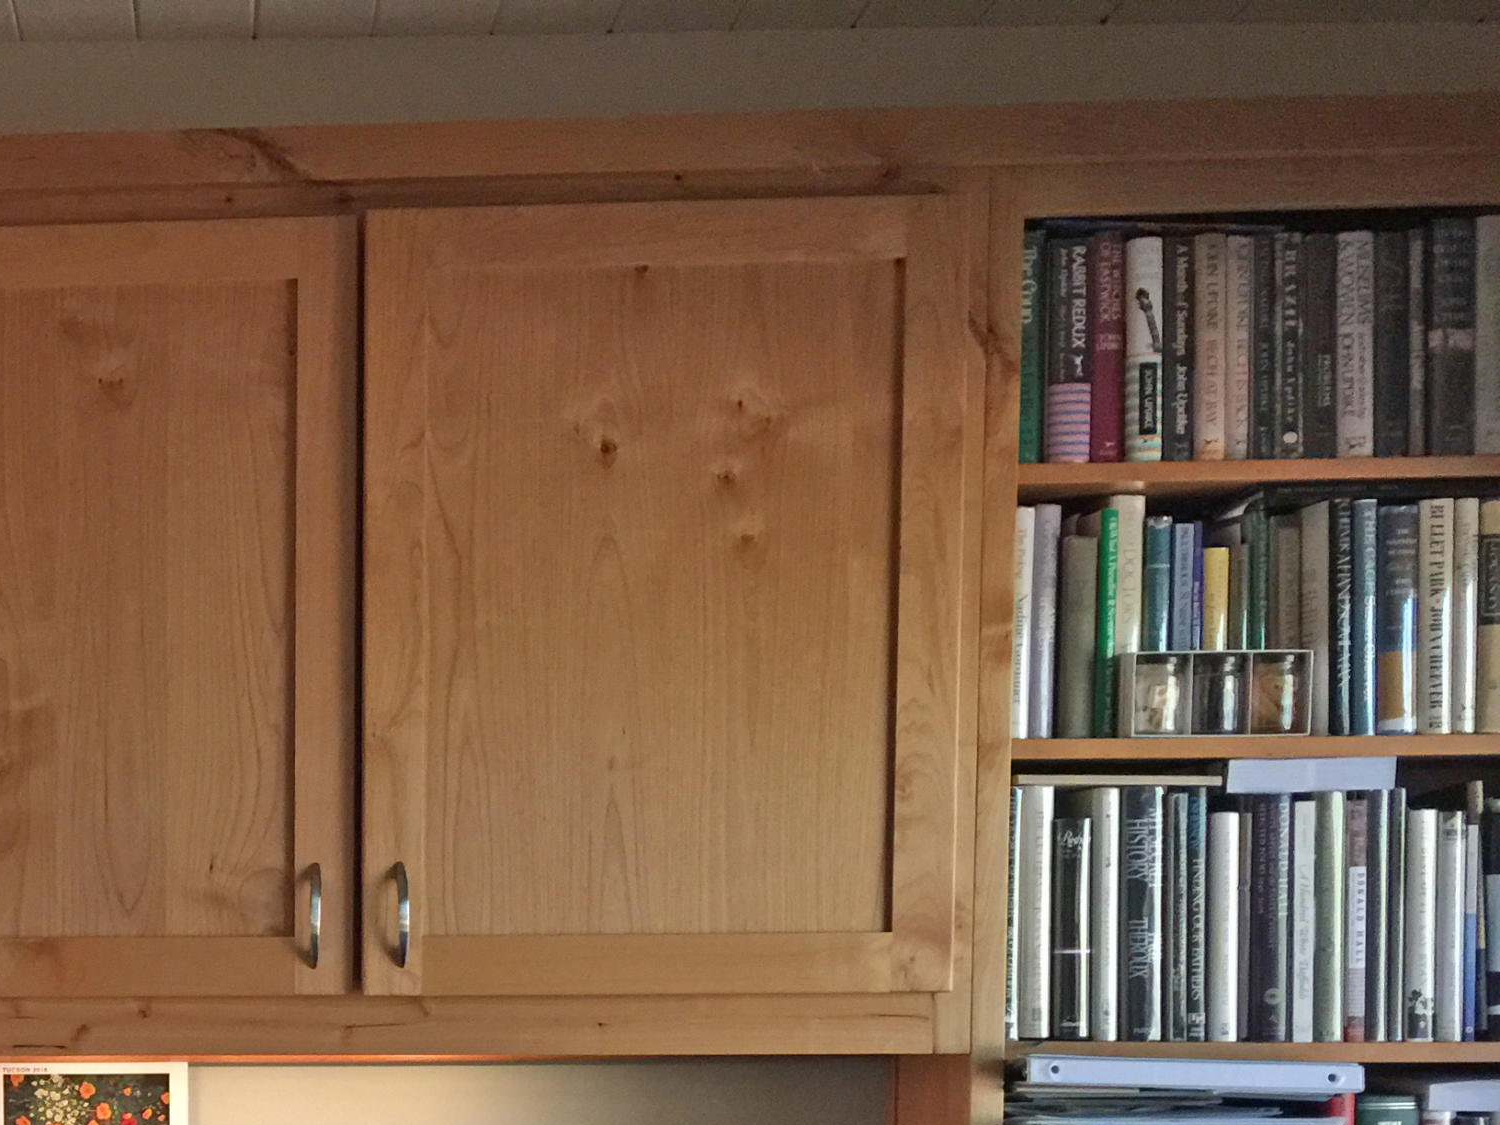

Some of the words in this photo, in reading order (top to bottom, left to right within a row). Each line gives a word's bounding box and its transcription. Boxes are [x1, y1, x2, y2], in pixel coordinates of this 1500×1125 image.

[1022, 247, 1037, 276] The
[1071, 245, 1088, 297] RABBIT
[1071, 299, 1088, 350] REDUX
[1176, 363, 1188, 391] John
[1172, 393, 1188, 435] Updike
[1429, 505, 1445, 557] BULLET
[1122, 548, 1138, 624] DOCTORS
[1429, 561, 1445, 598] PARK
[1125, 818, 1148, 882] HISTORY
[1191, 858, 1205, 911] FINDING
[1298, 882, 1310, 923] Hundred
[1355, 871, 1365, 922] DONALD
[1128, 917, 1148, 980] THEROUX
[1191, 915, 1205, 948] OUR
[1355, 930, 1364, 965] HALL
[1191, 950, 1205, 1001] FATHERS
